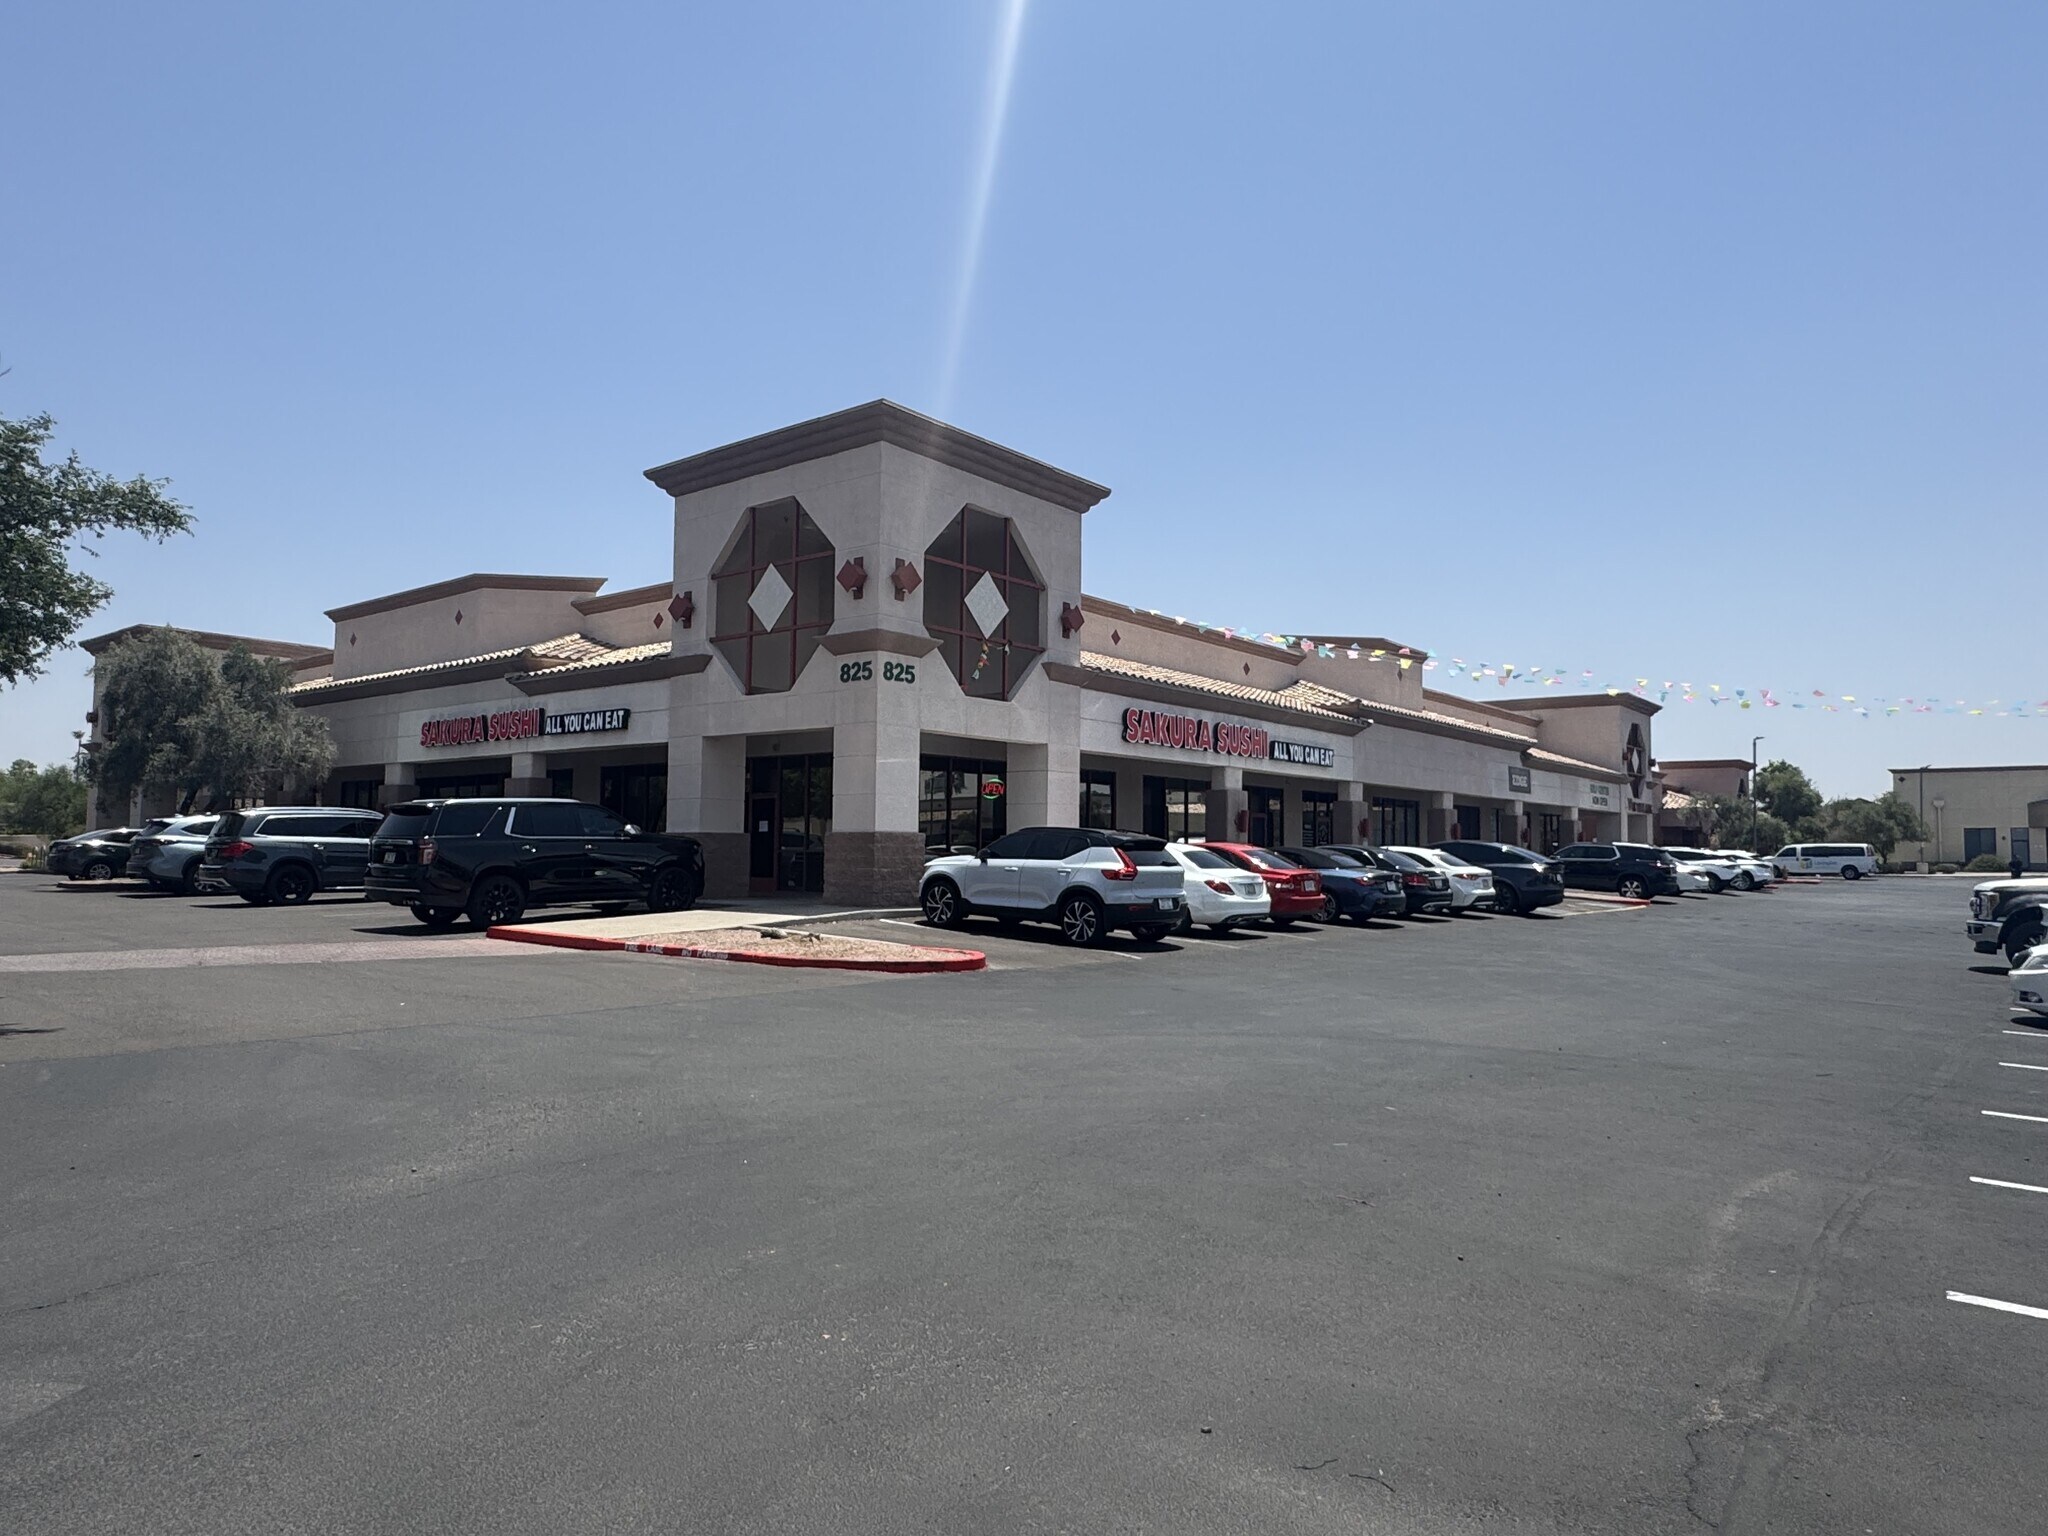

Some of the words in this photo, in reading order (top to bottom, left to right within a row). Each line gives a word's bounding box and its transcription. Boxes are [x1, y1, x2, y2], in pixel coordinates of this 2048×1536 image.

[840, 661, 873, 683] 825
[883, 661, 916, 684] 825
[420, 715, 485, 747] SAKURA
[487, 708, 540, 740] SUSHI
[545, 715, 562, 735] ALL
[564, 714, 582, 733] YOU
[584, 713, 603, 731] CAN
[605, 710, 625, 729] EAT
[1125, 707, 1213, 753] SAKURA
[1216, 721, 1270, 760] SUSHI
[1273, 742, 1288, 760] ALL
[1289, 744, 1304, 762] YOU
[1305, 746, 1320, 764] CAN
[1320, 748, 1334, 766] EAT
[981, 783, 1005, 795] OPEN
